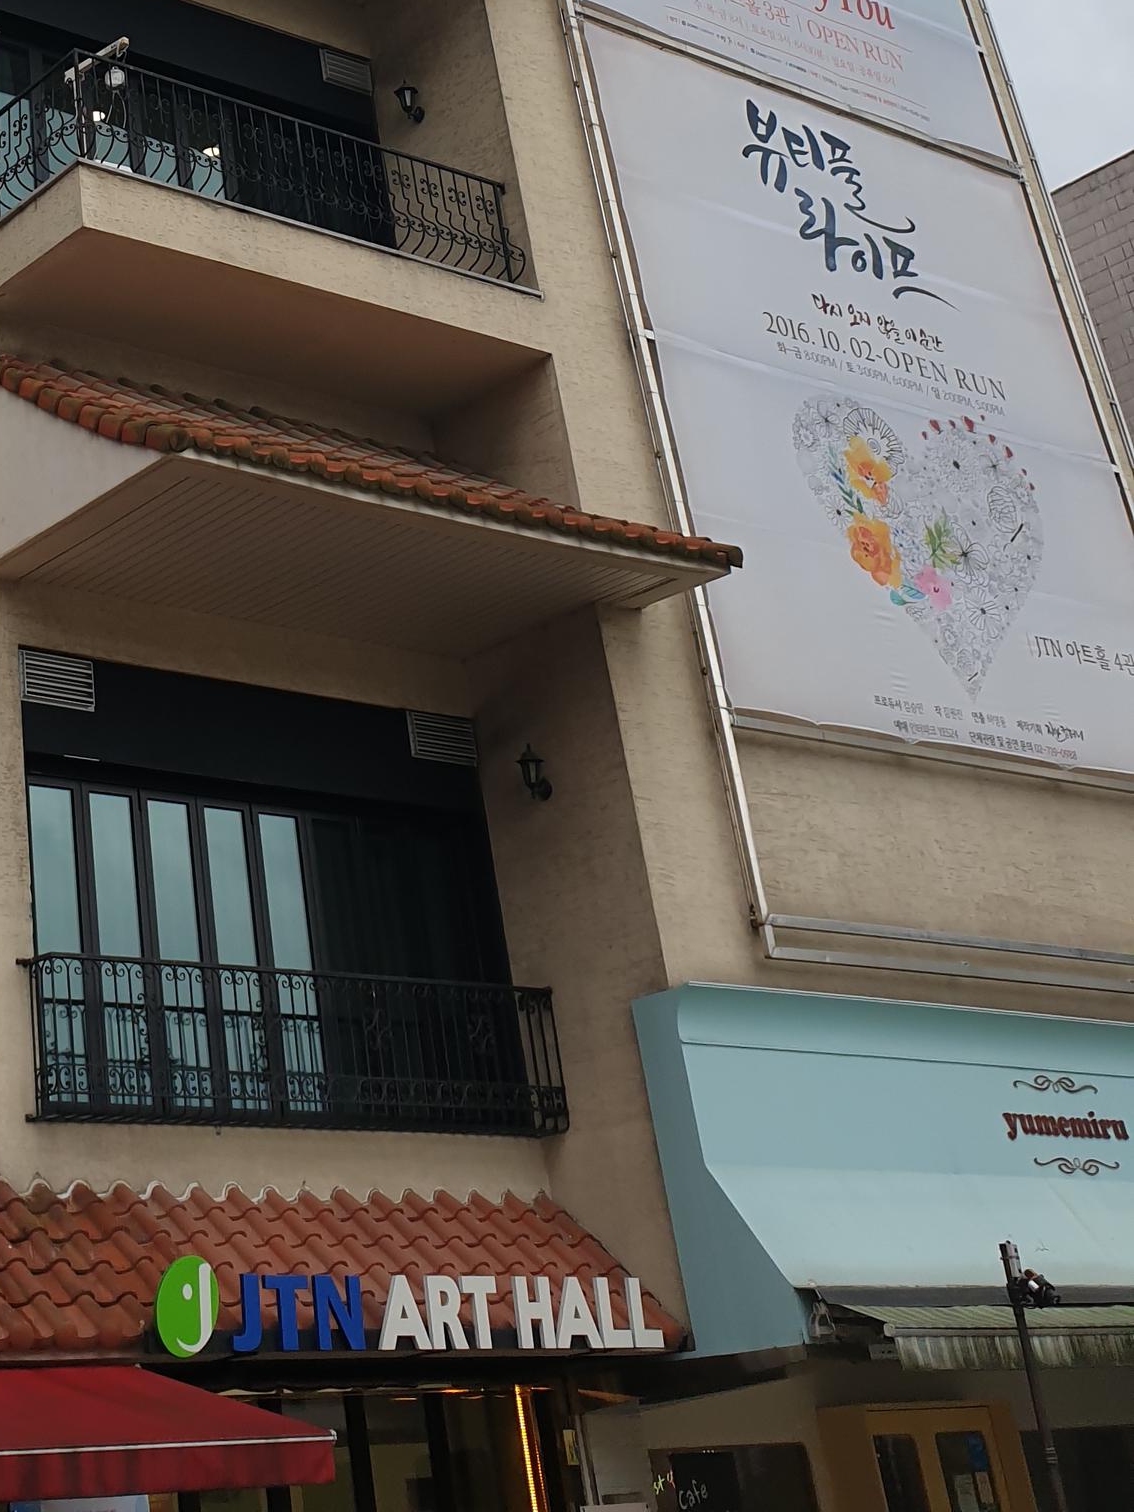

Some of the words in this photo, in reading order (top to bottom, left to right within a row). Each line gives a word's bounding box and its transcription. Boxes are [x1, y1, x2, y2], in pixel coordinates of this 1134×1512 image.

[763, 0, 791, 28] 3관
[807, 19, 860, 56] OPEN
[864, 46, 905, 72] RUN
[742, 99, 916, 233] 뷰티풀
[794, 187, 962, 313] 라이프
[847, 304, 871, 327] 오지
[954, 367, 1007, 401] RUN
[1034, 635, 1063, 658] JTN
[1065, 640, 1111, 672] 아트홀
[873, 695, 902, 712] 프로듀서
[1002, 1111, 1130, 1140] yumemiru
[233, 1274, 364, 1354] JTN
[377, 1275, 498, 1352] ART
[513, 1276, 666, 1351] HALL
[678, 1479, 709, 1510] Cafe
